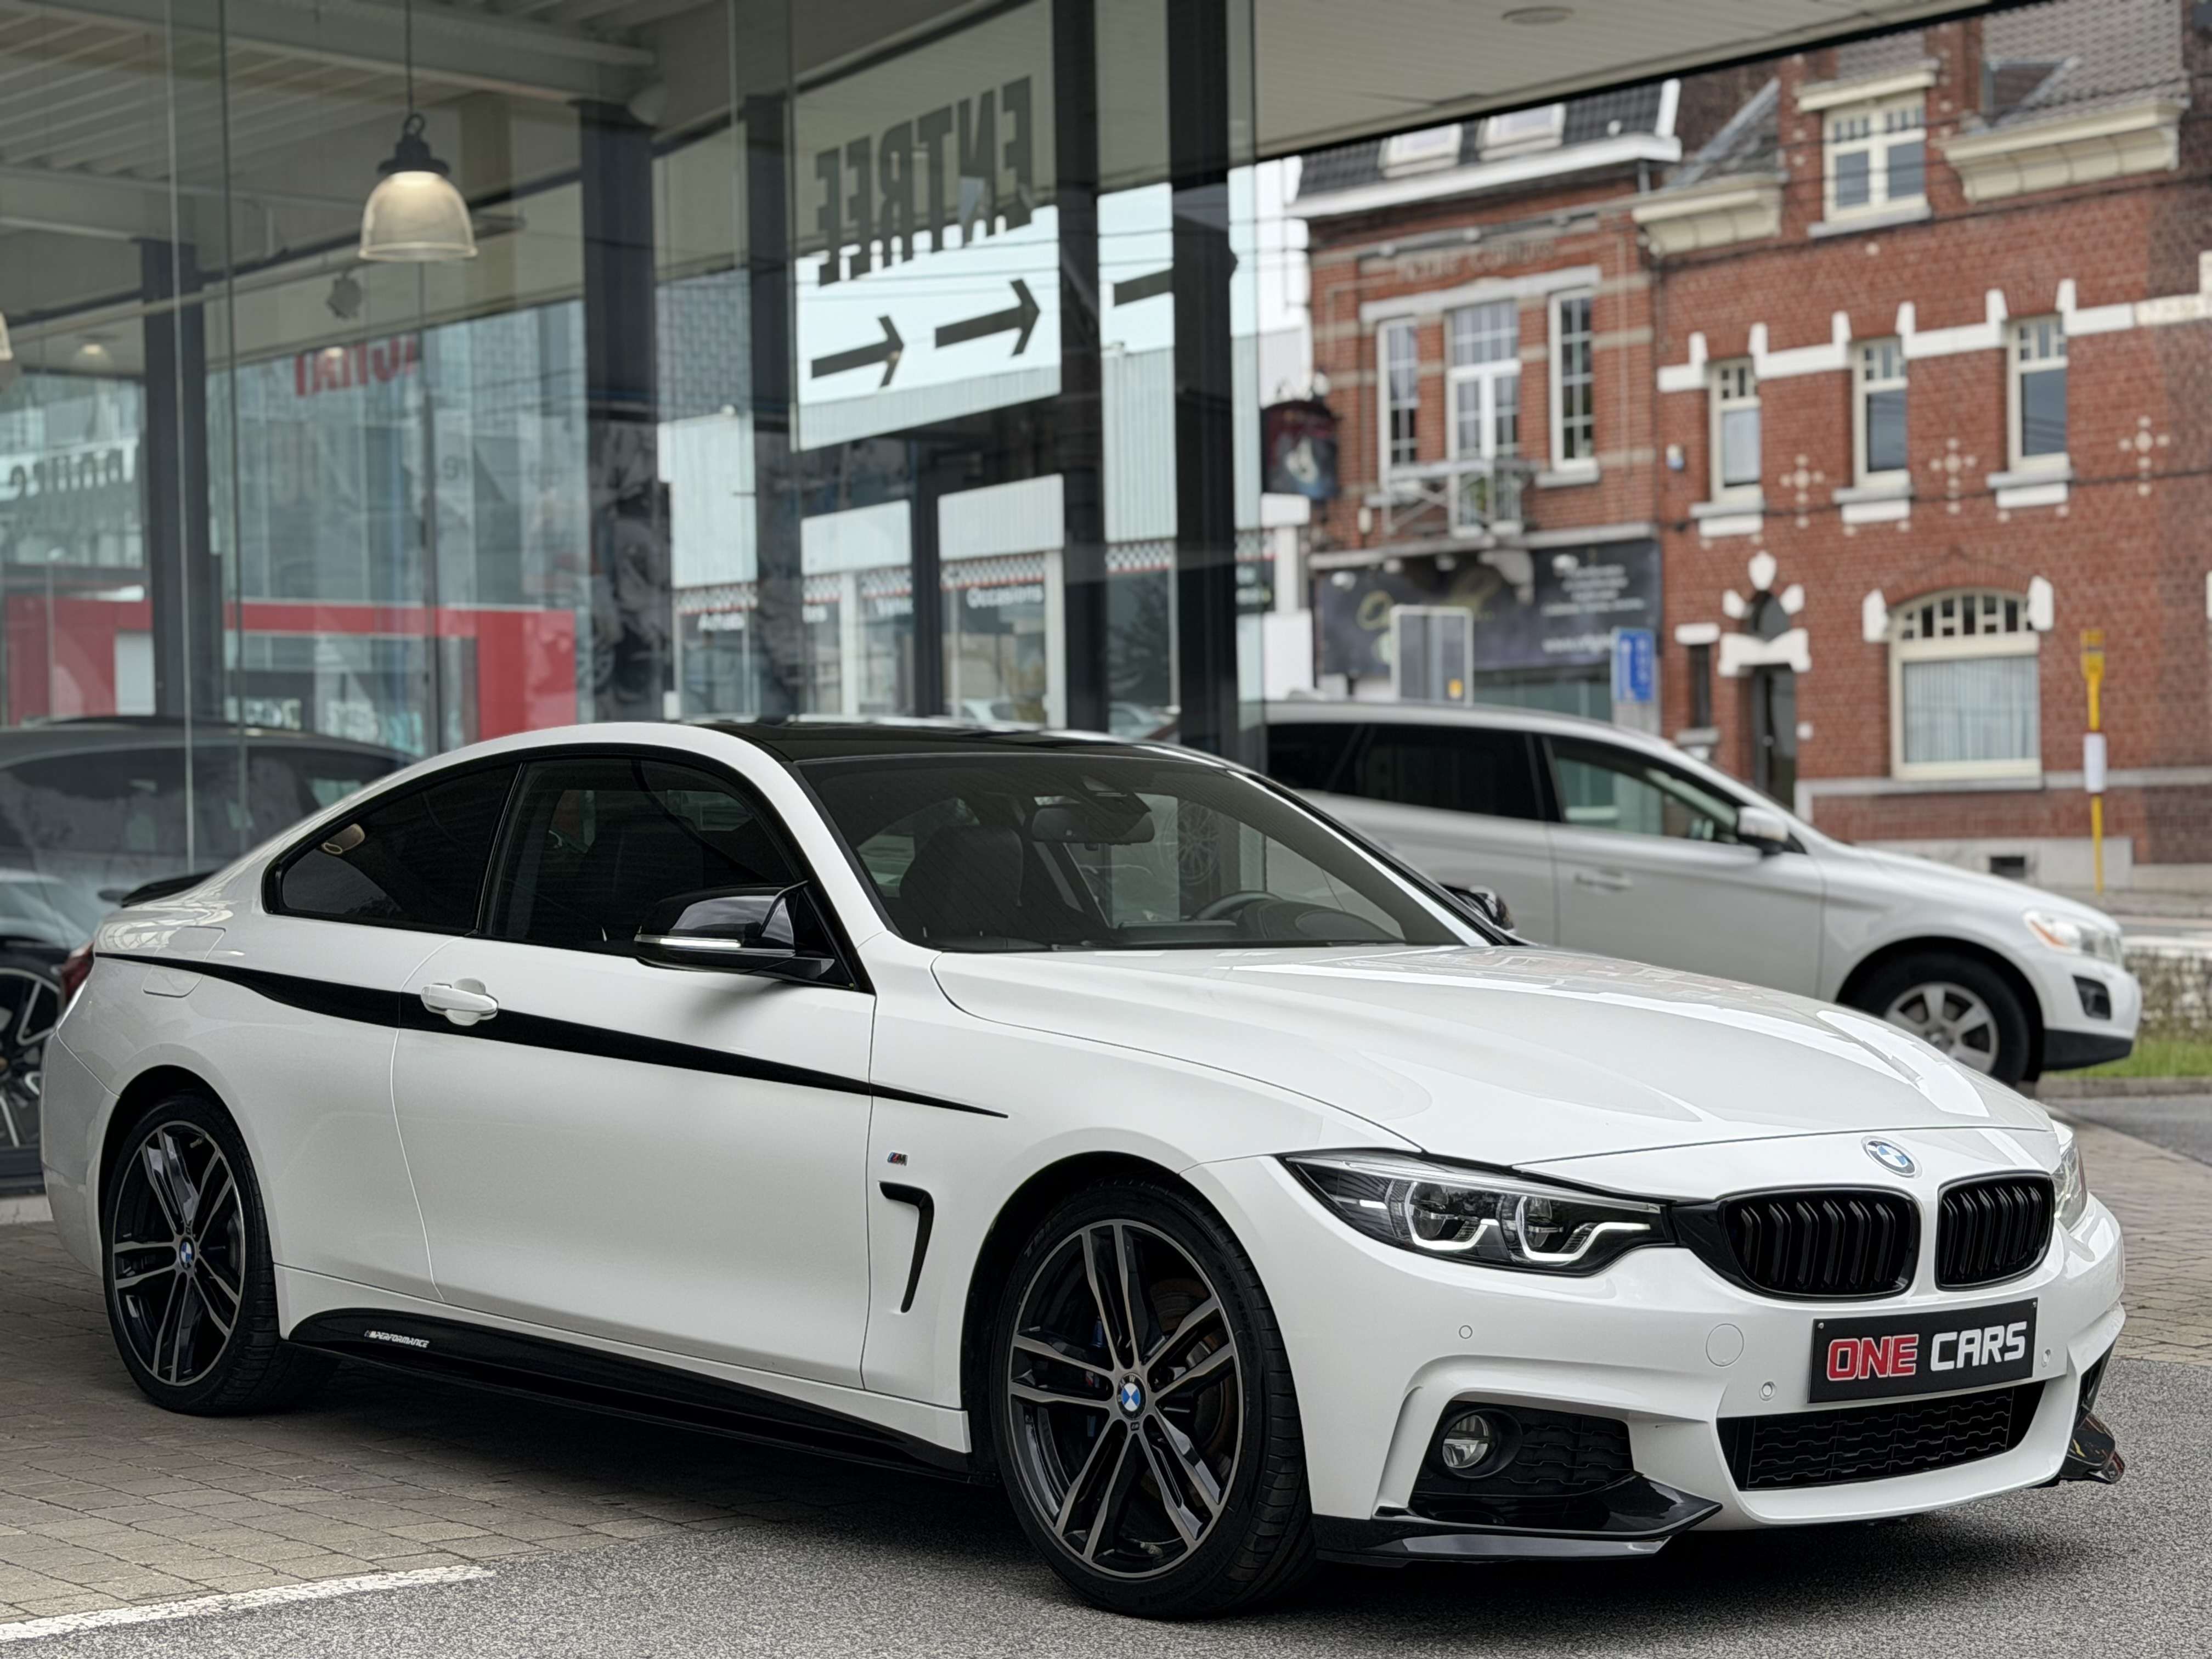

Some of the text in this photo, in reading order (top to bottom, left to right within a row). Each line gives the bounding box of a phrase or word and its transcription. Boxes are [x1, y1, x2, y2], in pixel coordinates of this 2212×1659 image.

[377, 1331, 430, 1348] PERFORMANCE
[1827, 1321, 2027, 1381] ONE CARS
